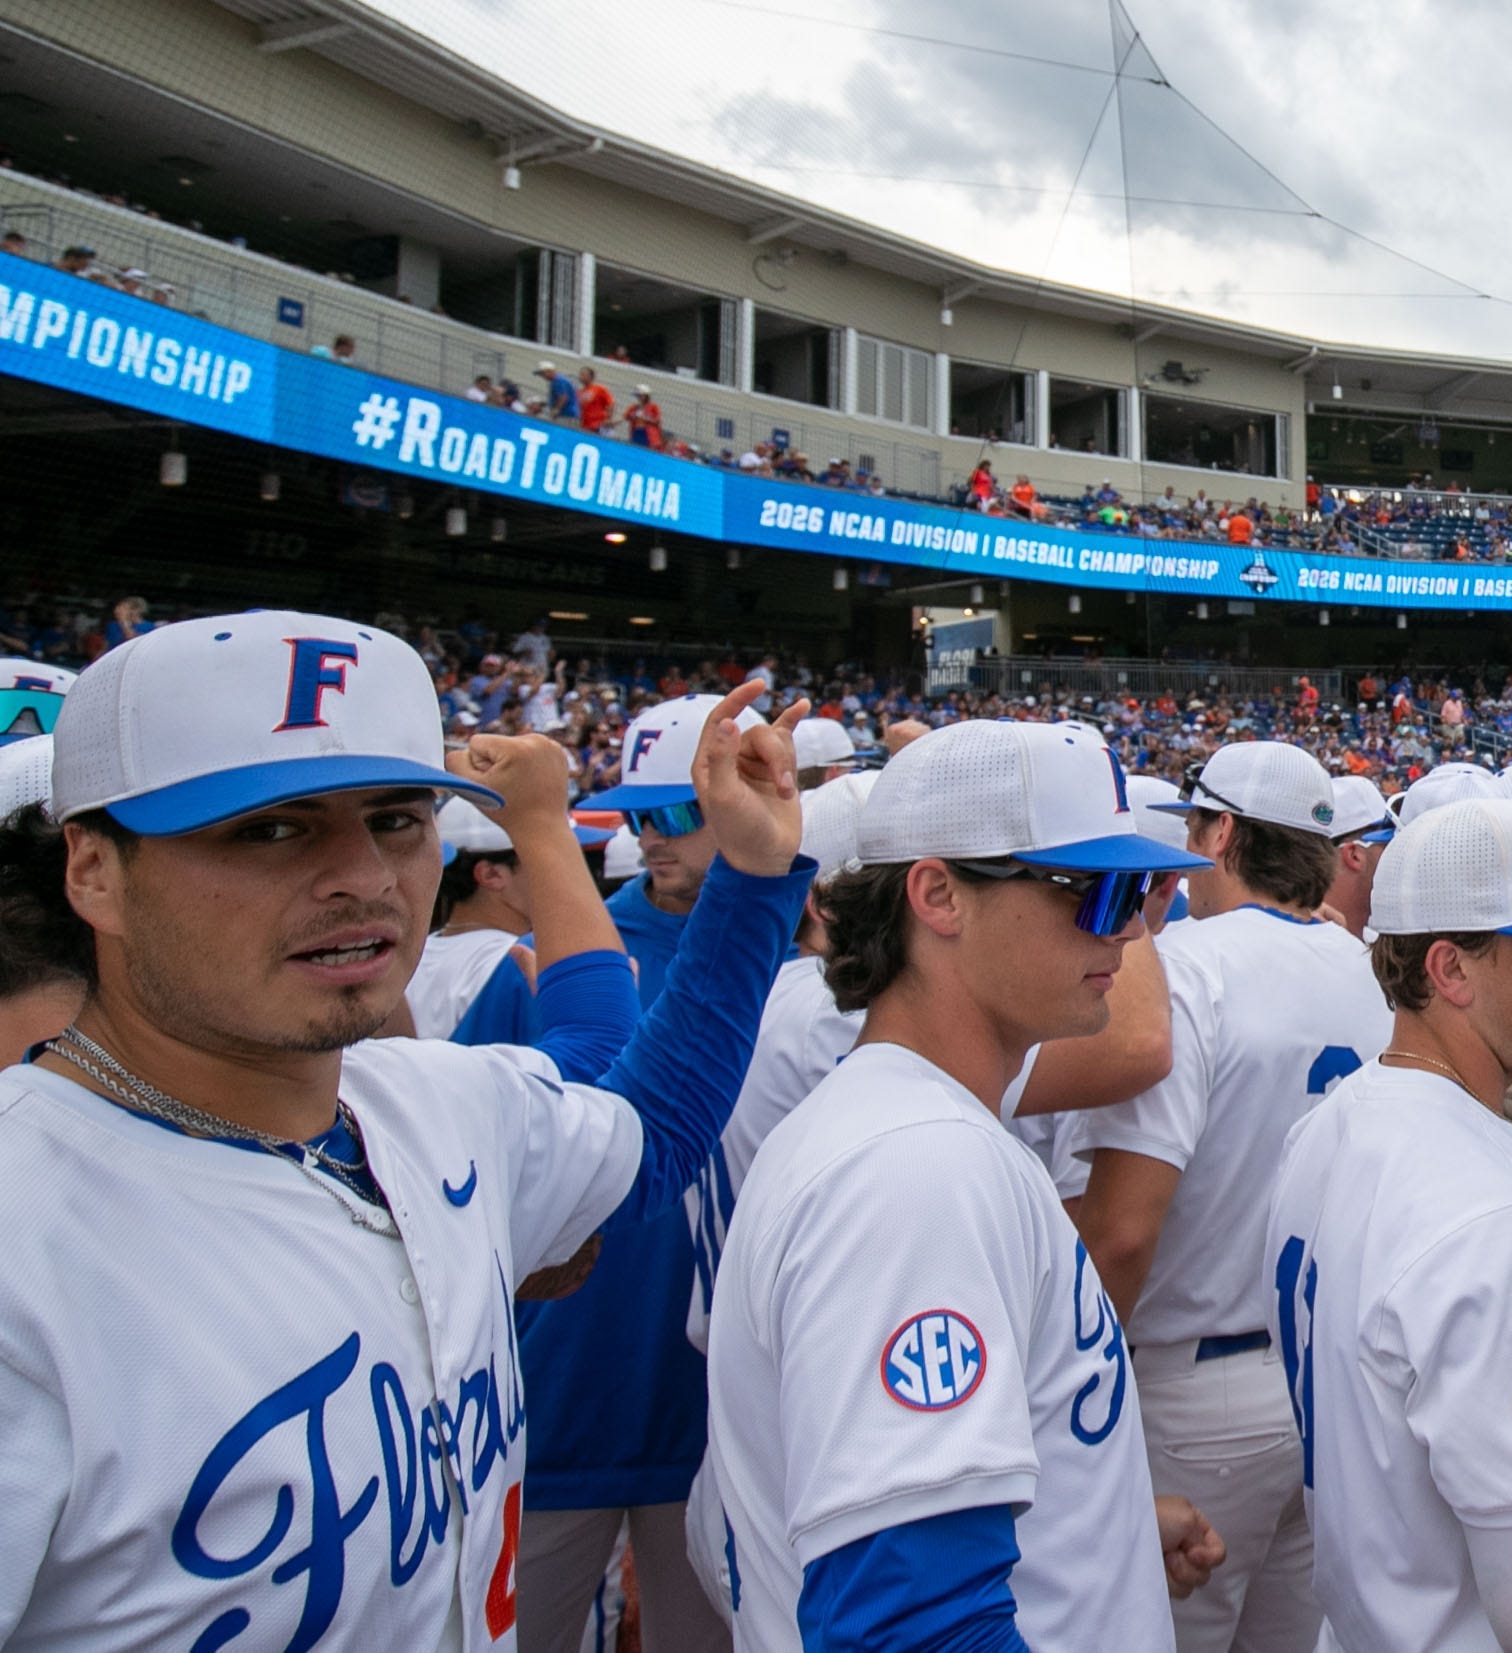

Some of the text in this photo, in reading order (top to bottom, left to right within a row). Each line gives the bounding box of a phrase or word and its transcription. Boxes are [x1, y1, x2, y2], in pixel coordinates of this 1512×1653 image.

[760, 500, 824, 533] 2026
[829, 511, 886, 543] NCAA
[891, 520, 978, 555] DIVISION
[994, 536, 1074, 569] BASEBALL
[1079, 549, 1220, 580] CHAMPIONSHIP
[1297, 567, 1340, 590] 2026
[1343, 572, 1382, 593] NCAA
[1386, 575, 1458, 596] DIVISION
[271, 636, 359, 733] F
[628, 728, 663, 773] F
[889, 1315, 980, 1405] SEC
